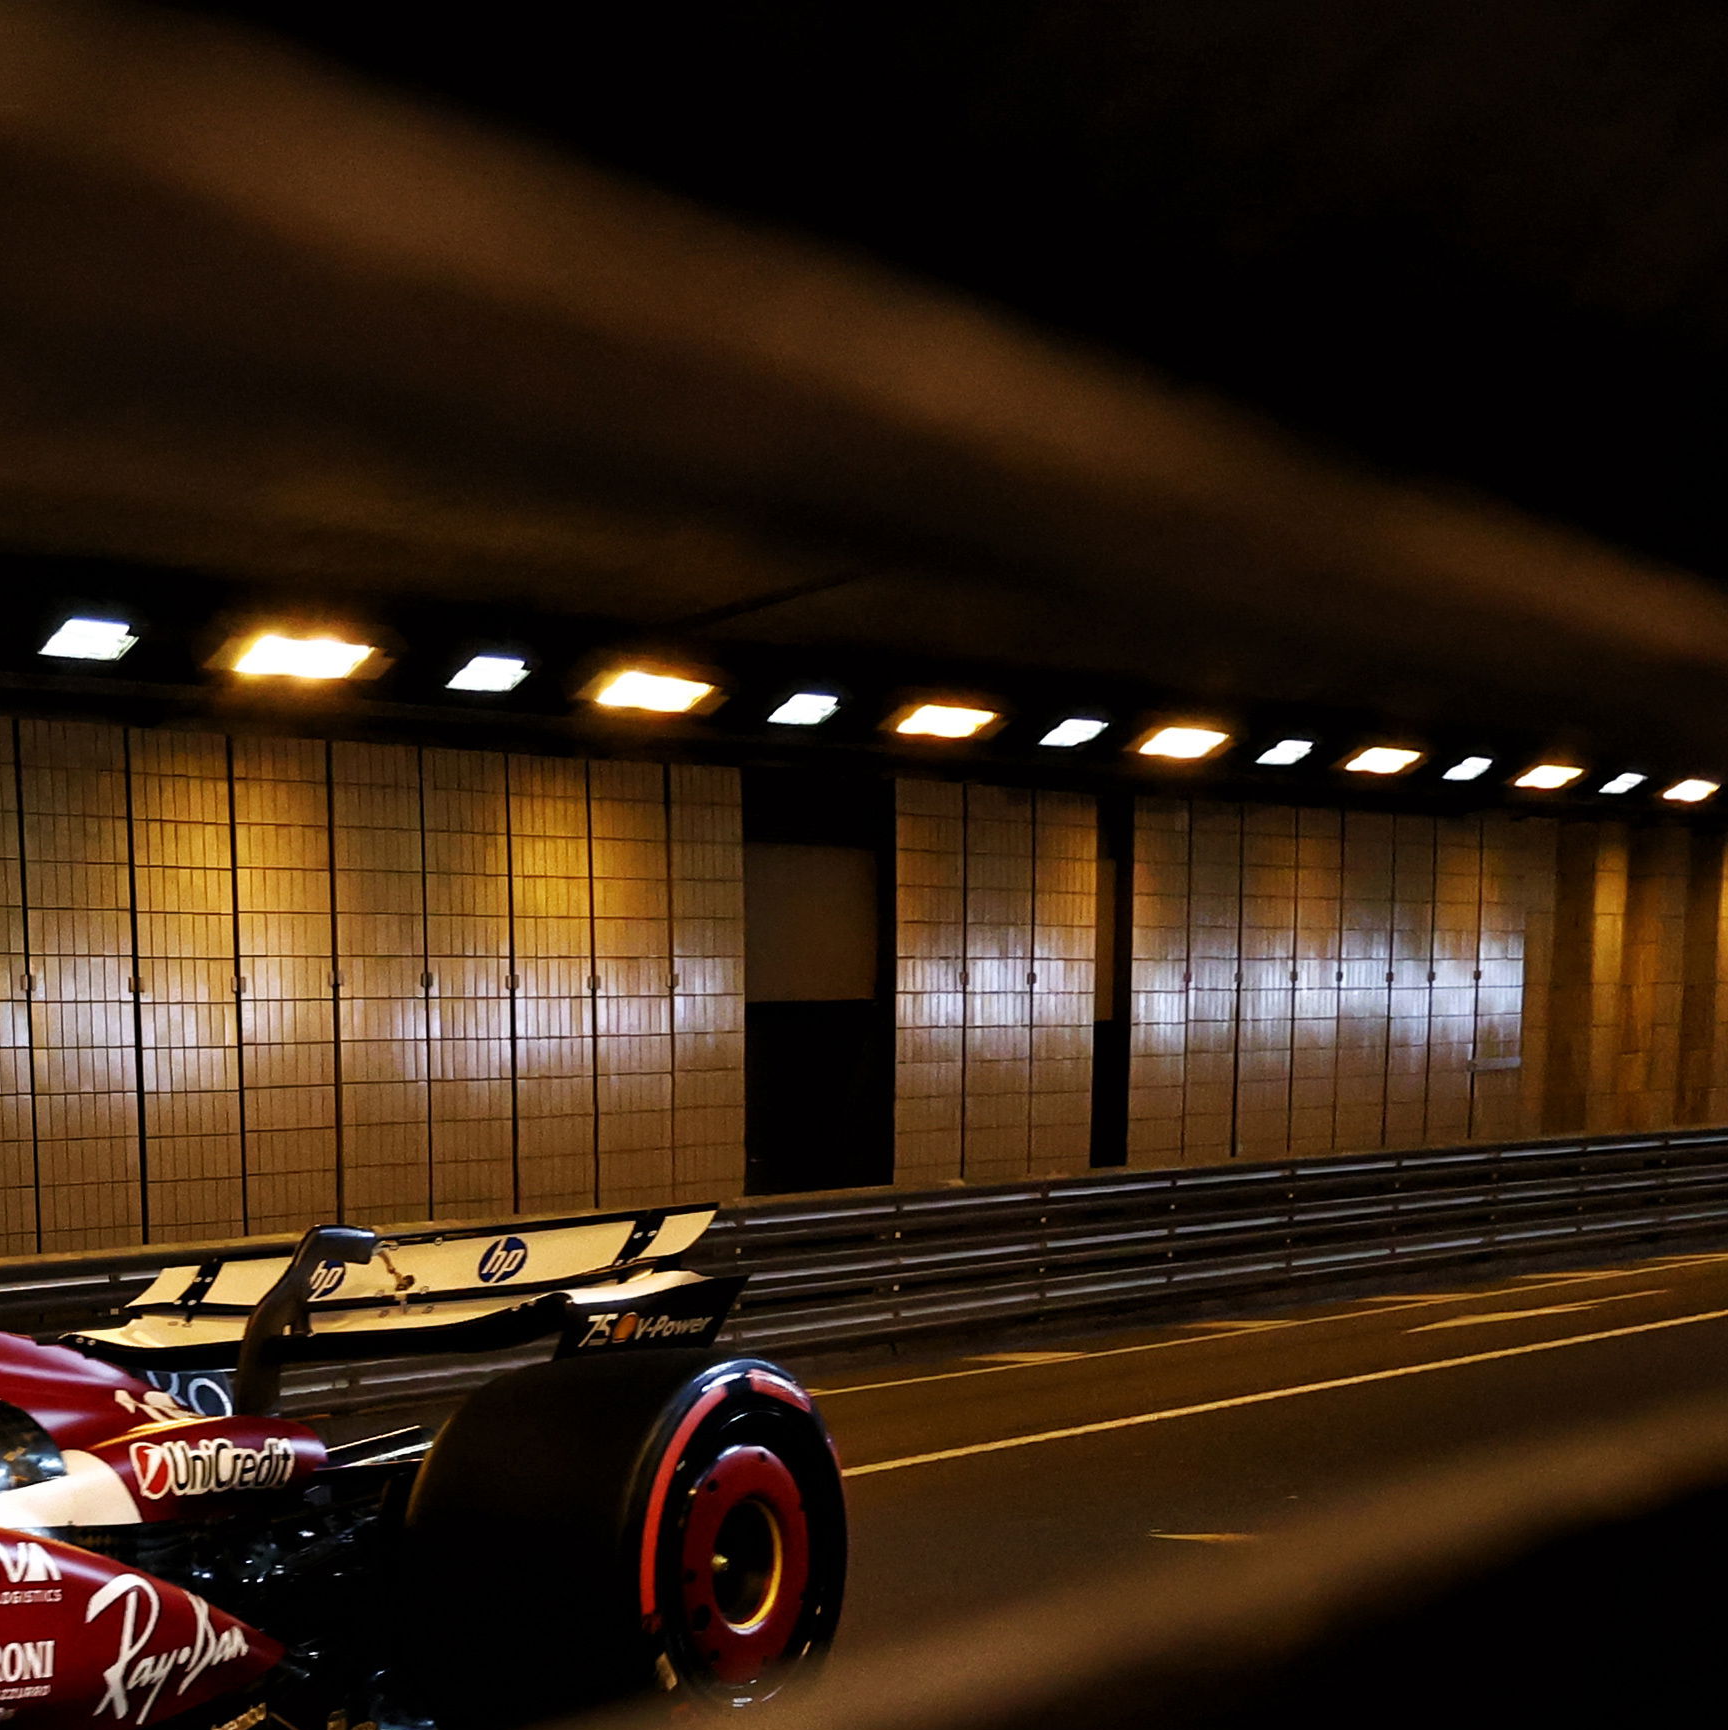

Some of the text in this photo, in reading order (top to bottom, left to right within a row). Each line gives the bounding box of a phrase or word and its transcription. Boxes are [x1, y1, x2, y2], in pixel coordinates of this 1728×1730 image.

[309, 1258, 344, 1300] hp
[485, 1237, 524, 1283] hp
[163, 1438, 294, 1497] UniCredit
